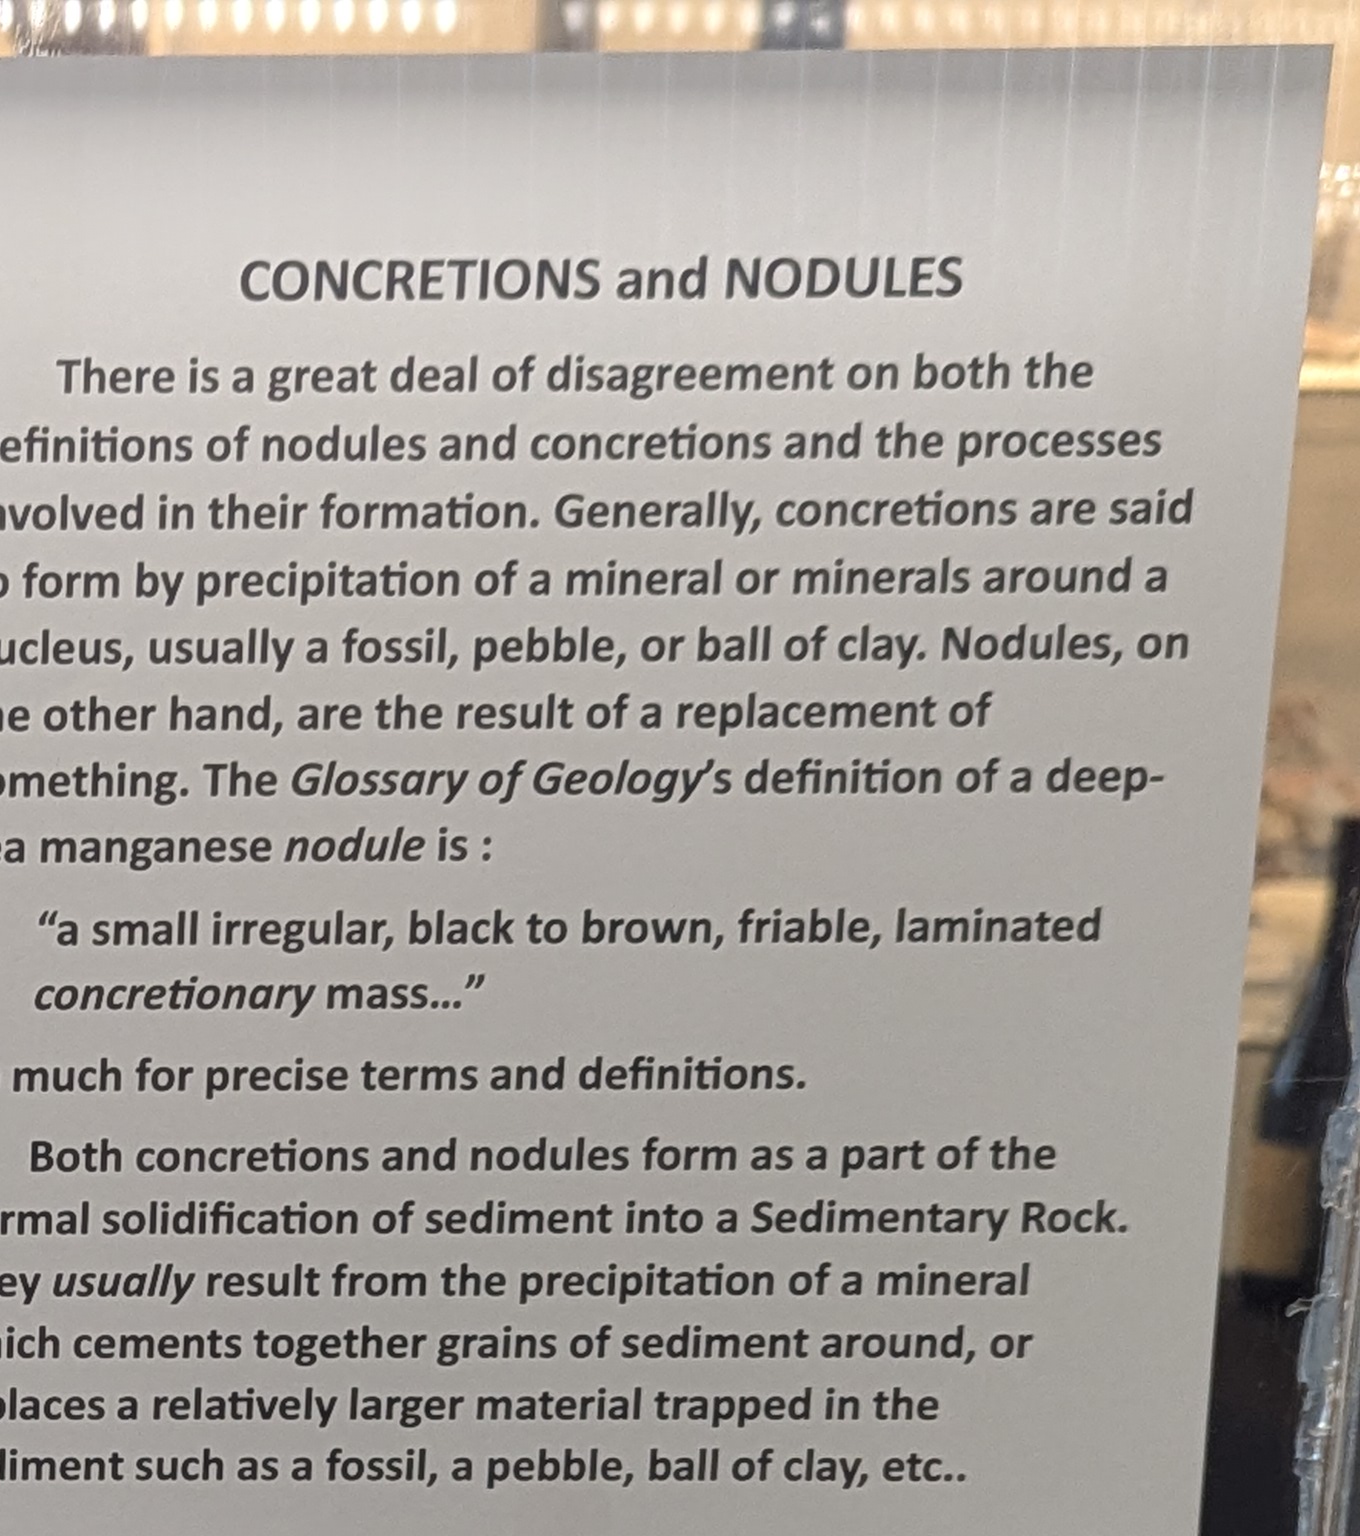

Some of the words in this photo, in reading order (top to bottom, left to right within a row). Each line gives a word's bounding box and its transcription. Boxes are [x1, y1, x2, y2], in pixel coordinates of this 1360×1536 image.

[241, 259, 600, 301] CONCRETIONS
[617, 255, 708, 299] and
[726, 256, 962, 299] NODULES
[57, 357, 175, 393] There
[190, 358, 219, 393] is
[233, 367, 253, 393] a
[268, 361, 377, 402] great
[390, 355, 478, 392] deal
[493, 355, 536, 392] of
[547, 355, 834, 400] disagreement
[847, 363, 898, 390] on
[914, 352, 1010, 389] both
[1024, 351, 1093, 388] the
[39, 911, 78, 946] “a
[92, 910, 198, 946] small
[213, 910, 393, 953] irregular,
[409, 909, 514, 944] black
[526, 914, 567, 944] to
[582, 909, 723, 950] brown,
[738, 908, 881, 949] friable,
[896, 907, 1102, 942] laminated
[13, 1058, 121, 1092] much
[135, 1057, 194, 1091] for
[206, 1058, 348, 1100] precise
[361, 1061, 478, 1091] terms
[490, 1056, 565, 1090] and
[579, 1056, 805, 1090] definitions.
